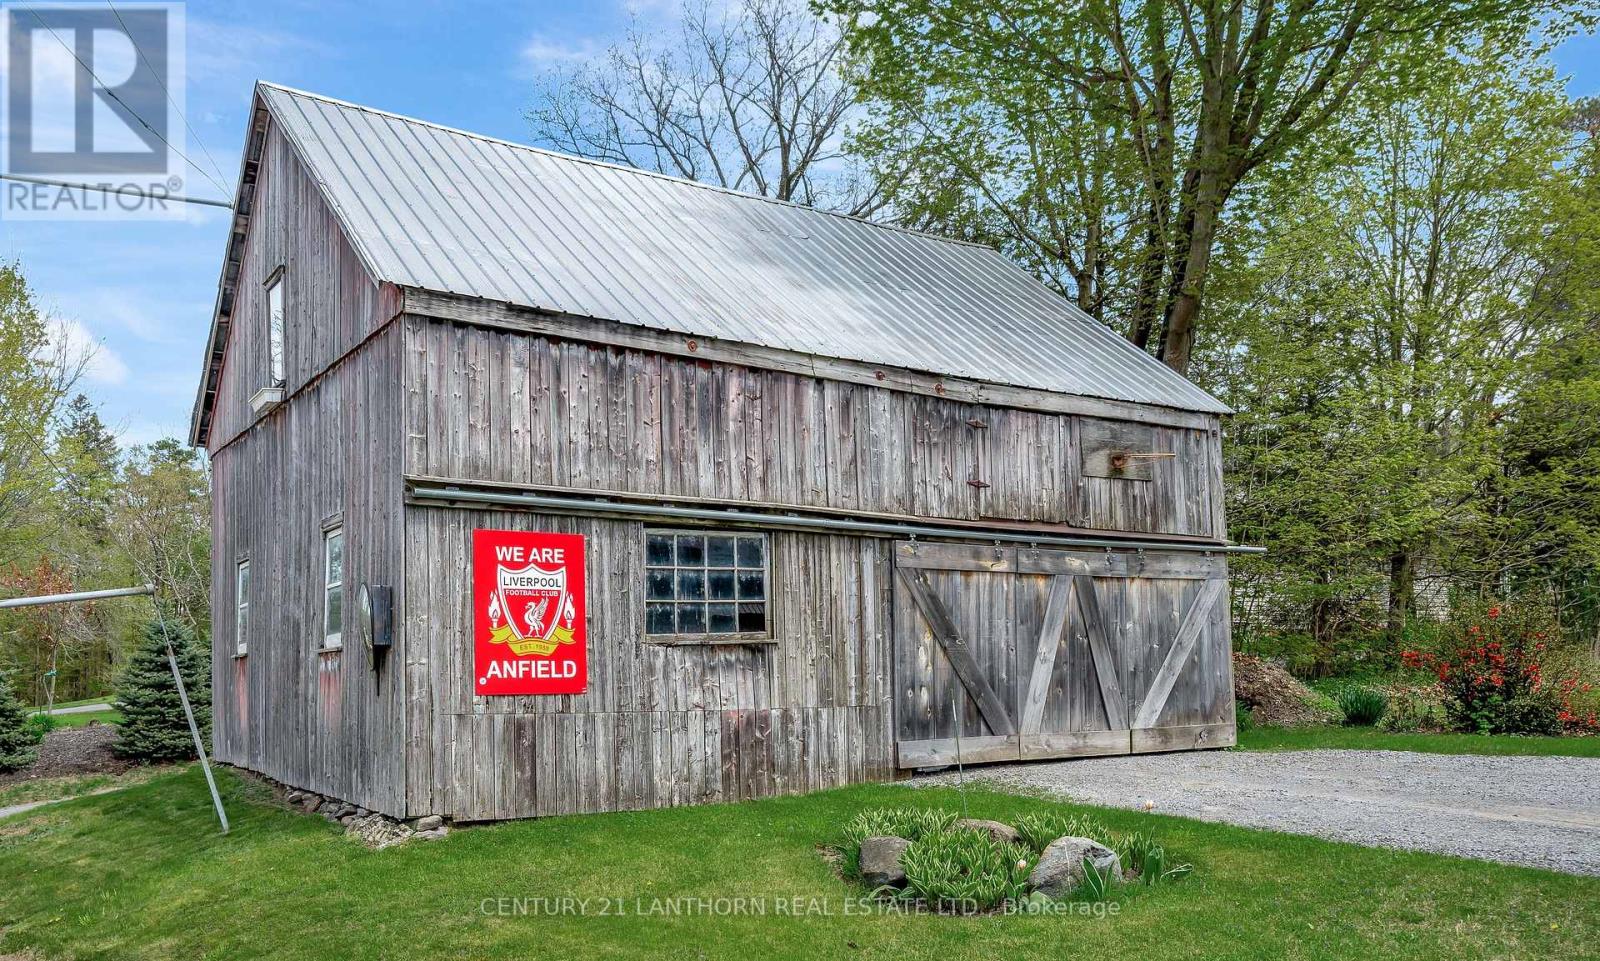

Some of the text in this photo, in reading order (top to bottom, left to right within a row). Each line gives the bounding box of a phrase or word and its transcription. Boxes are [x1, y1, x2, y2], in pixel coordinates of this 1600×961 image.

[495, 546, 565, 563] WE ARE
[503, 576, 561, 588] LIVERPOOL
[505, 589, 540, 597] FOOTBALL
[486, 660, 577, 678] ANFIELD
